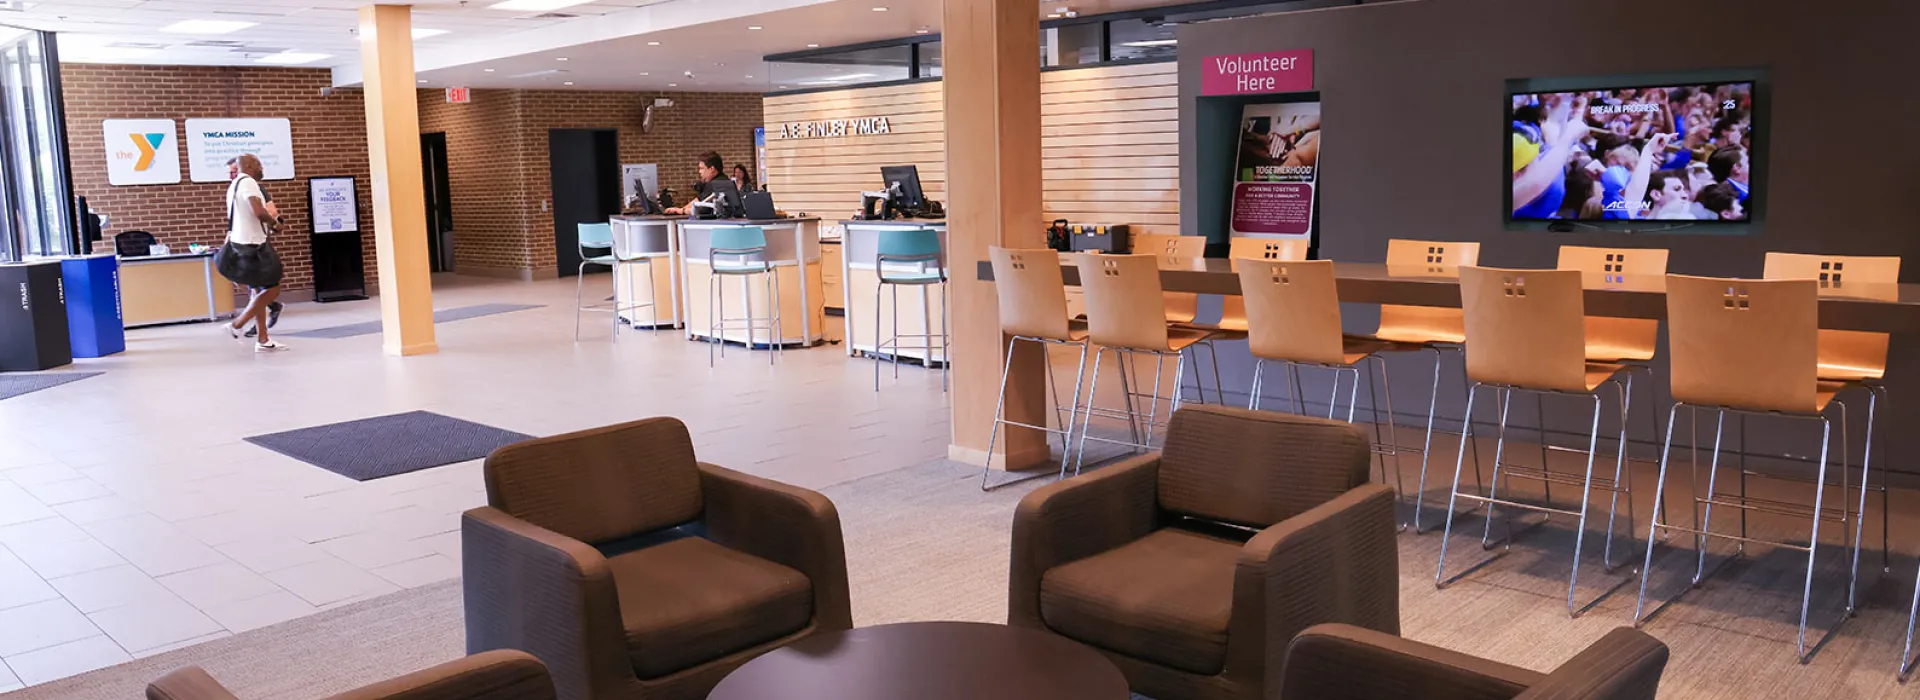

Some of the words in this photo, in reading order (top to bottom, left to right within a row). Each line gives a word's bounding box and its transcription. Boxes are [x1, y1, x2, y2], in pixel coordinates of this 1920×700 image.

[1216, 56, 1297, 75] Volunteer
[1237, 74, 1276, 91] Here
[451, 88, 467, 101] EXIT
[1591, 105, 1613, 114] BREAK
[1614, 105, 1621, 113] IN
[1623, 104, 1660, 113] PROGRESS
[806, 120, 848, 137] FINLEY
[851, 117, 892, 134] YMCA
[115, 150, 133, 160] the
[1255, 166, 1312, 174] TOGETHERHOOD
[20, 282, 28, 305] TRASH
